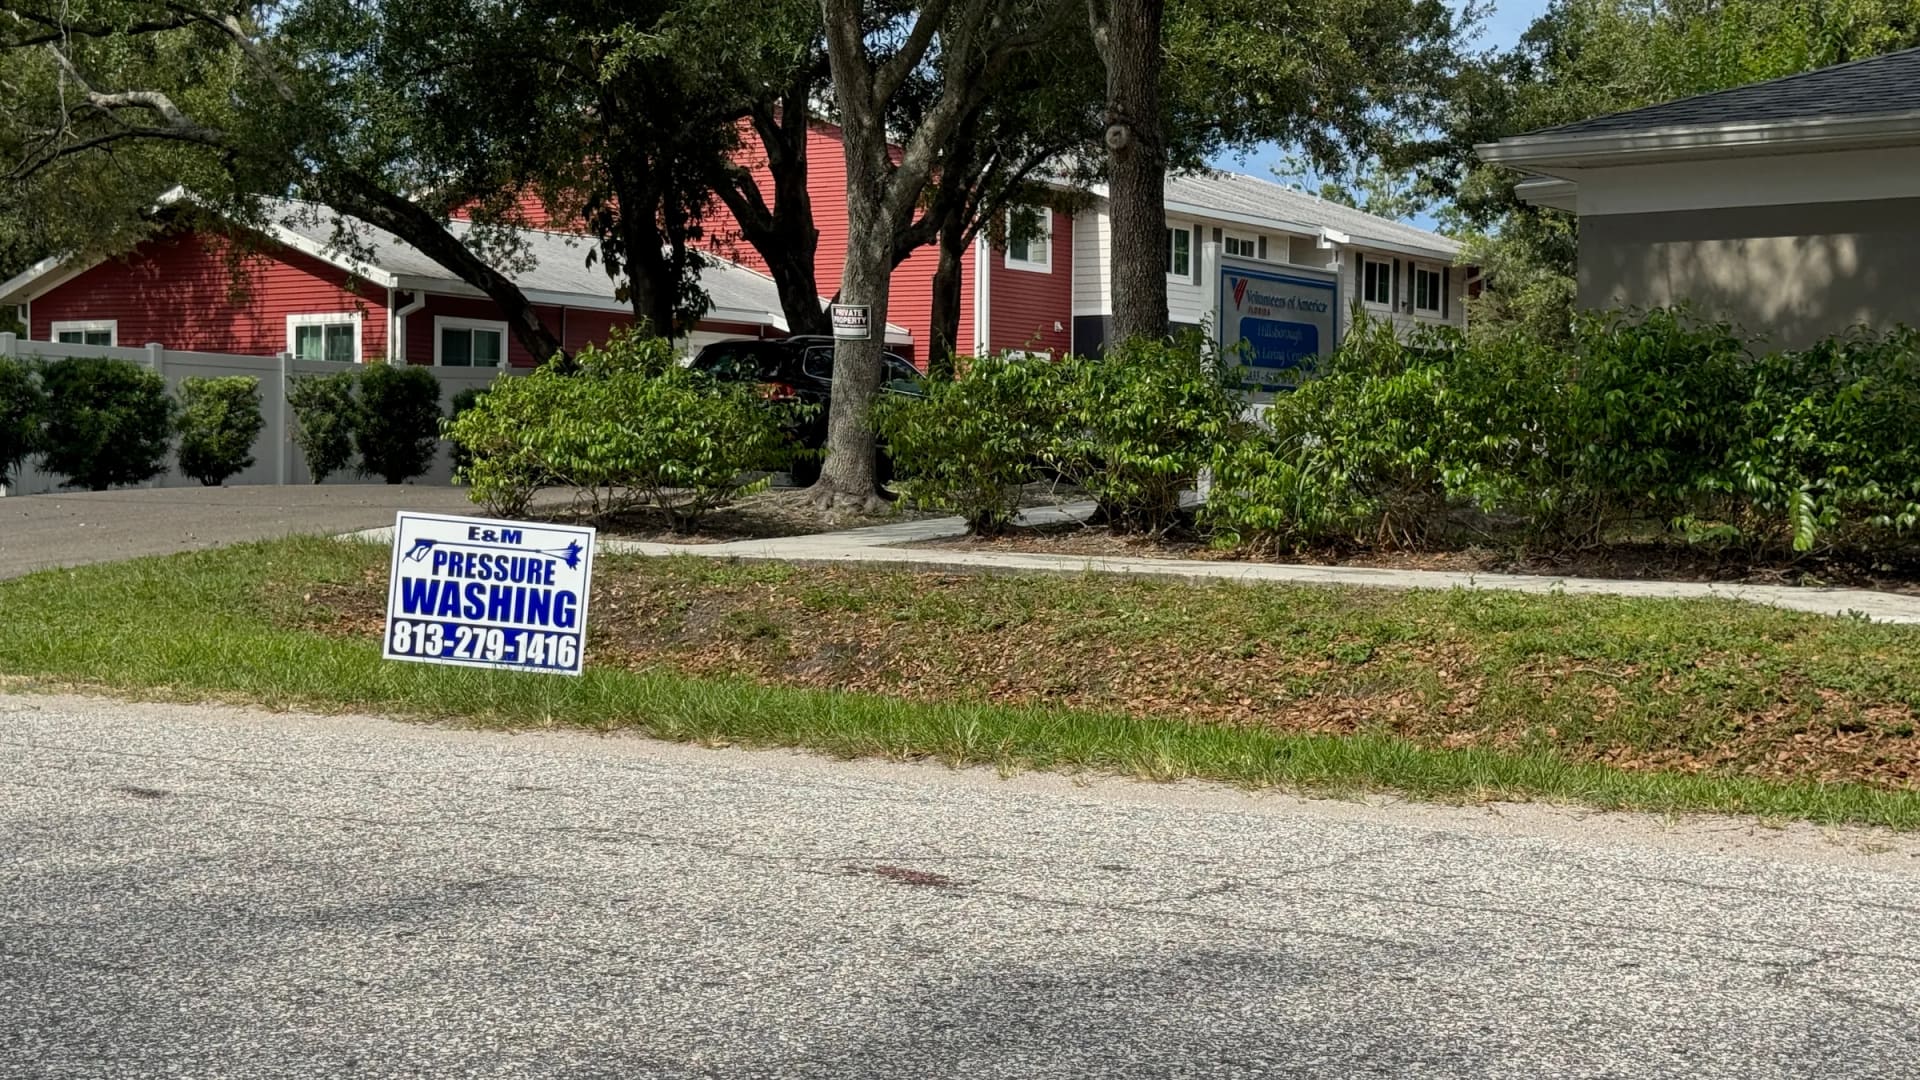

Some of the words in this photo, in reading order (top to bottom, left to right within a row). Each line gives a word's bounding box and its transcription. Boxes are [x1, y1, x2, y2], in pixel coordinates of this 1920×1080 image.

[1246, 290, 1285, 308] Volunteers
[1287, 296, 1296, 310] of
[1297, 297, 1328, 313] America
[1248, 306, 1271, 316] FLORIDA
[833, 316, 867, 324] PROPERTY
[467, 525, 523, 545] E&M
[431, 549, 557, 586] PRESSURE
[401, 576, 578, 629] WASHING
[392, 620, 578, 668] 813-279-1416
